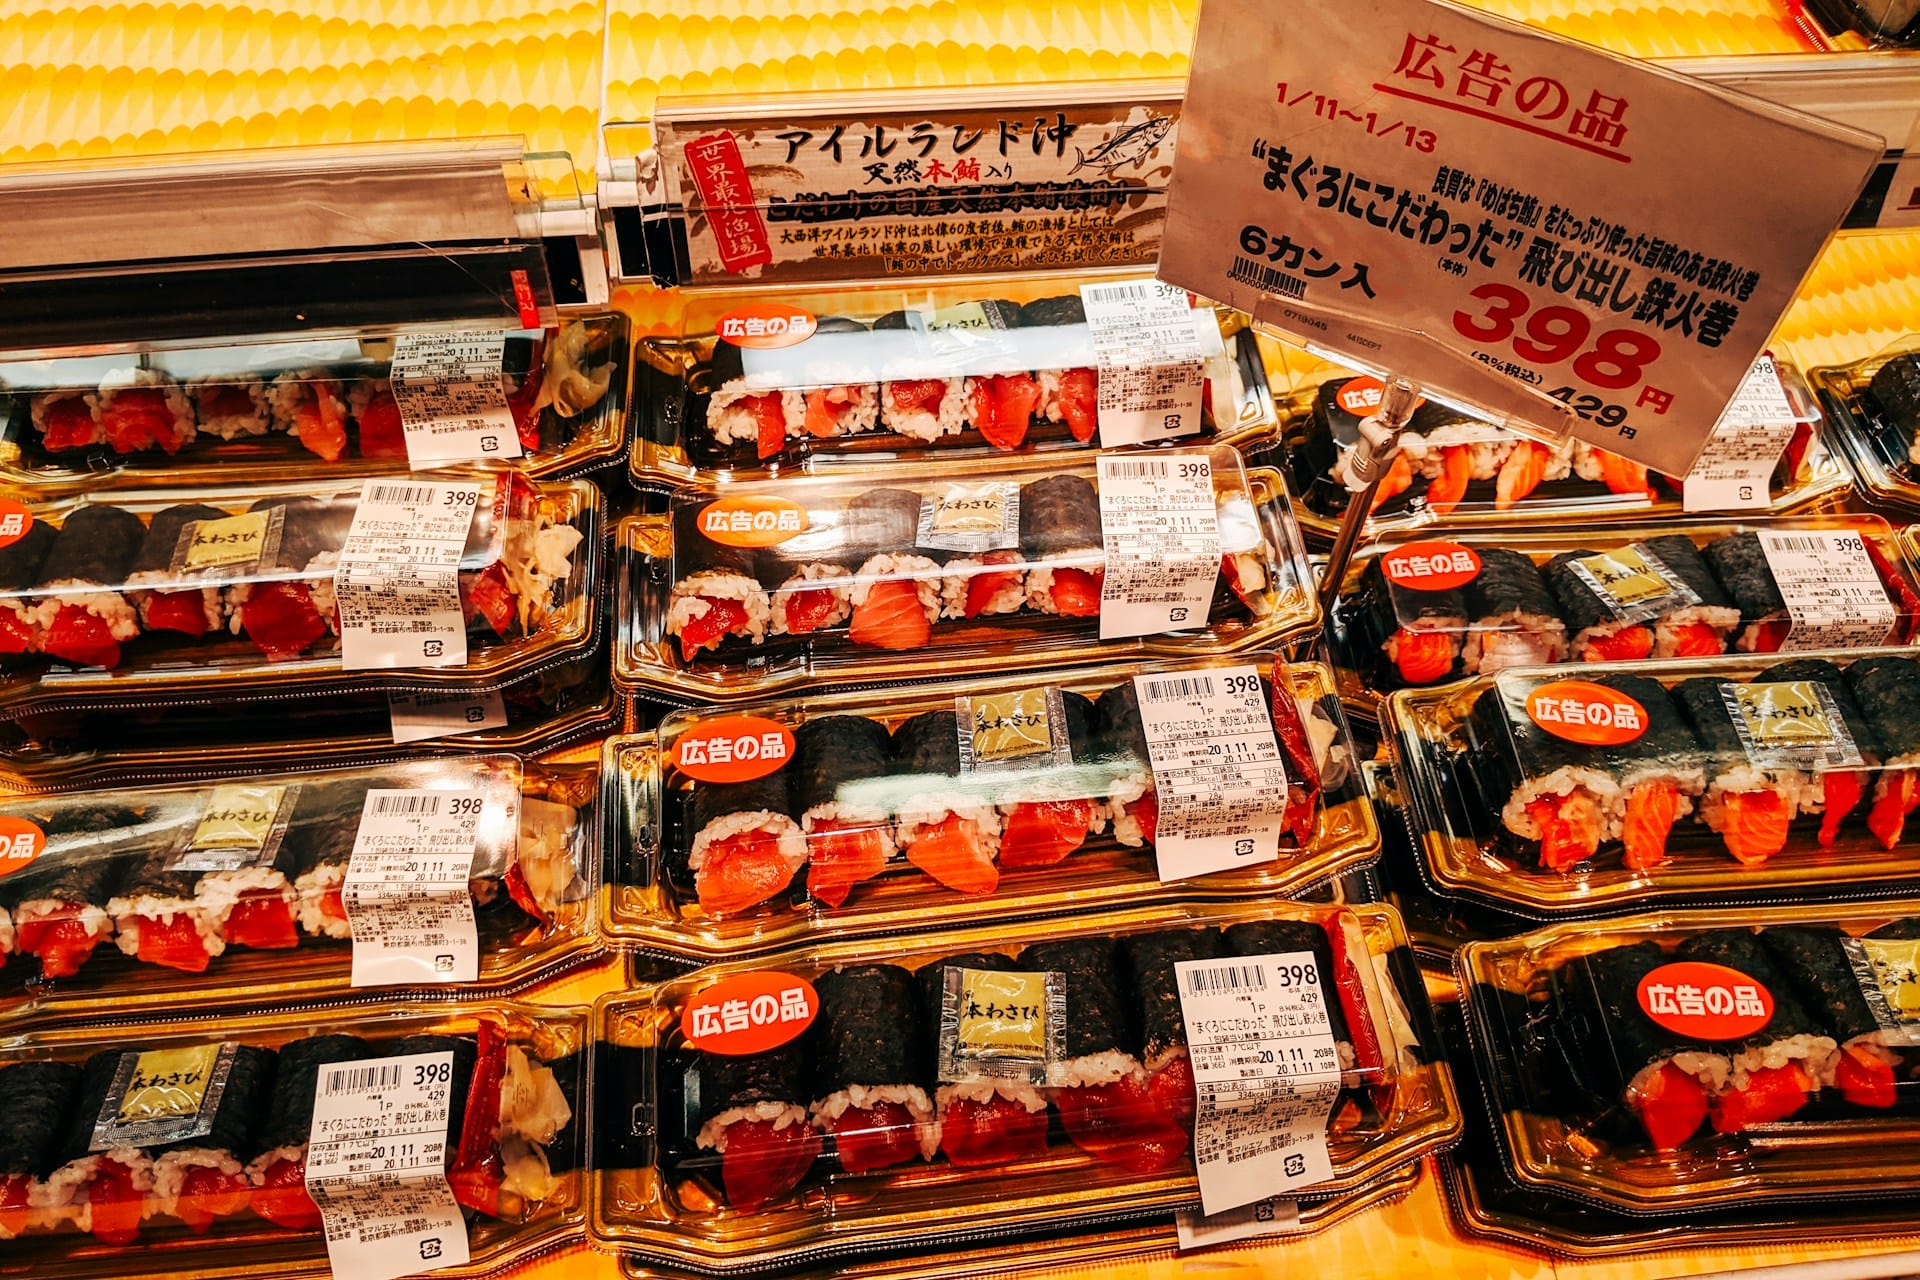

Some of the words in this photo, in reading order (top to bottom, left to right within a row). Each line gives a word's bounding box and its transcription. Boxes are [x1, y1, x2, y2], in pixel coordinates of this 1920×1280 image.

[1393, 33, 1629, 147] 広告の品
[775, 113, 1079, 164] アイルランド沖
[862, 157, 1013, 185] 天然本鮪入り
[697, 145, 758, 254] 世界最北漁場
[1240, 225, 1376, 299] 6カン入
[1438, 258, 1468, 277] (本体)
[1518, 236, 1740, 347] 飛び出し鉄火巻
[722, 315, 810, 337] 広告の品
[1178, 463, 1209, 477] 398
[443, 491, 476, 506] 398
[705, 509, 801, 532] 広告の品
[192, 531, 258, 546] 本わさび
[1833, 538, 1863, 551] 398
[1387, 552, 1476, 580] 広告の品
[1224, 675, 1260, 694] 398
[1244, 698, 1260, 707] 429
[1534, 696, 1641, 731] 広告の品
[679, 732, 787, 766] 広告の品
[449, 798, 483, 815] 398
[460, 820, 476, 828] 429
[1277, 964, 1317, 987] 398
[1300, 993, 1318, 1003] 429
[1646, 983, 1766, 1017] 広告の品
[691, 987, 810, 1039] 広告の品
[963, 1001, 1039, 1020] 本わさび
[1272, 1012, 1327, 1027] 飛び出し鉄火巻
[1314, 1047, 1334, 1058] 20時
[129, 1069, 202, 1093] 本わさび
[413, 1062, 450, 1086] 398
[427, 1090, 445, 1100] 429
